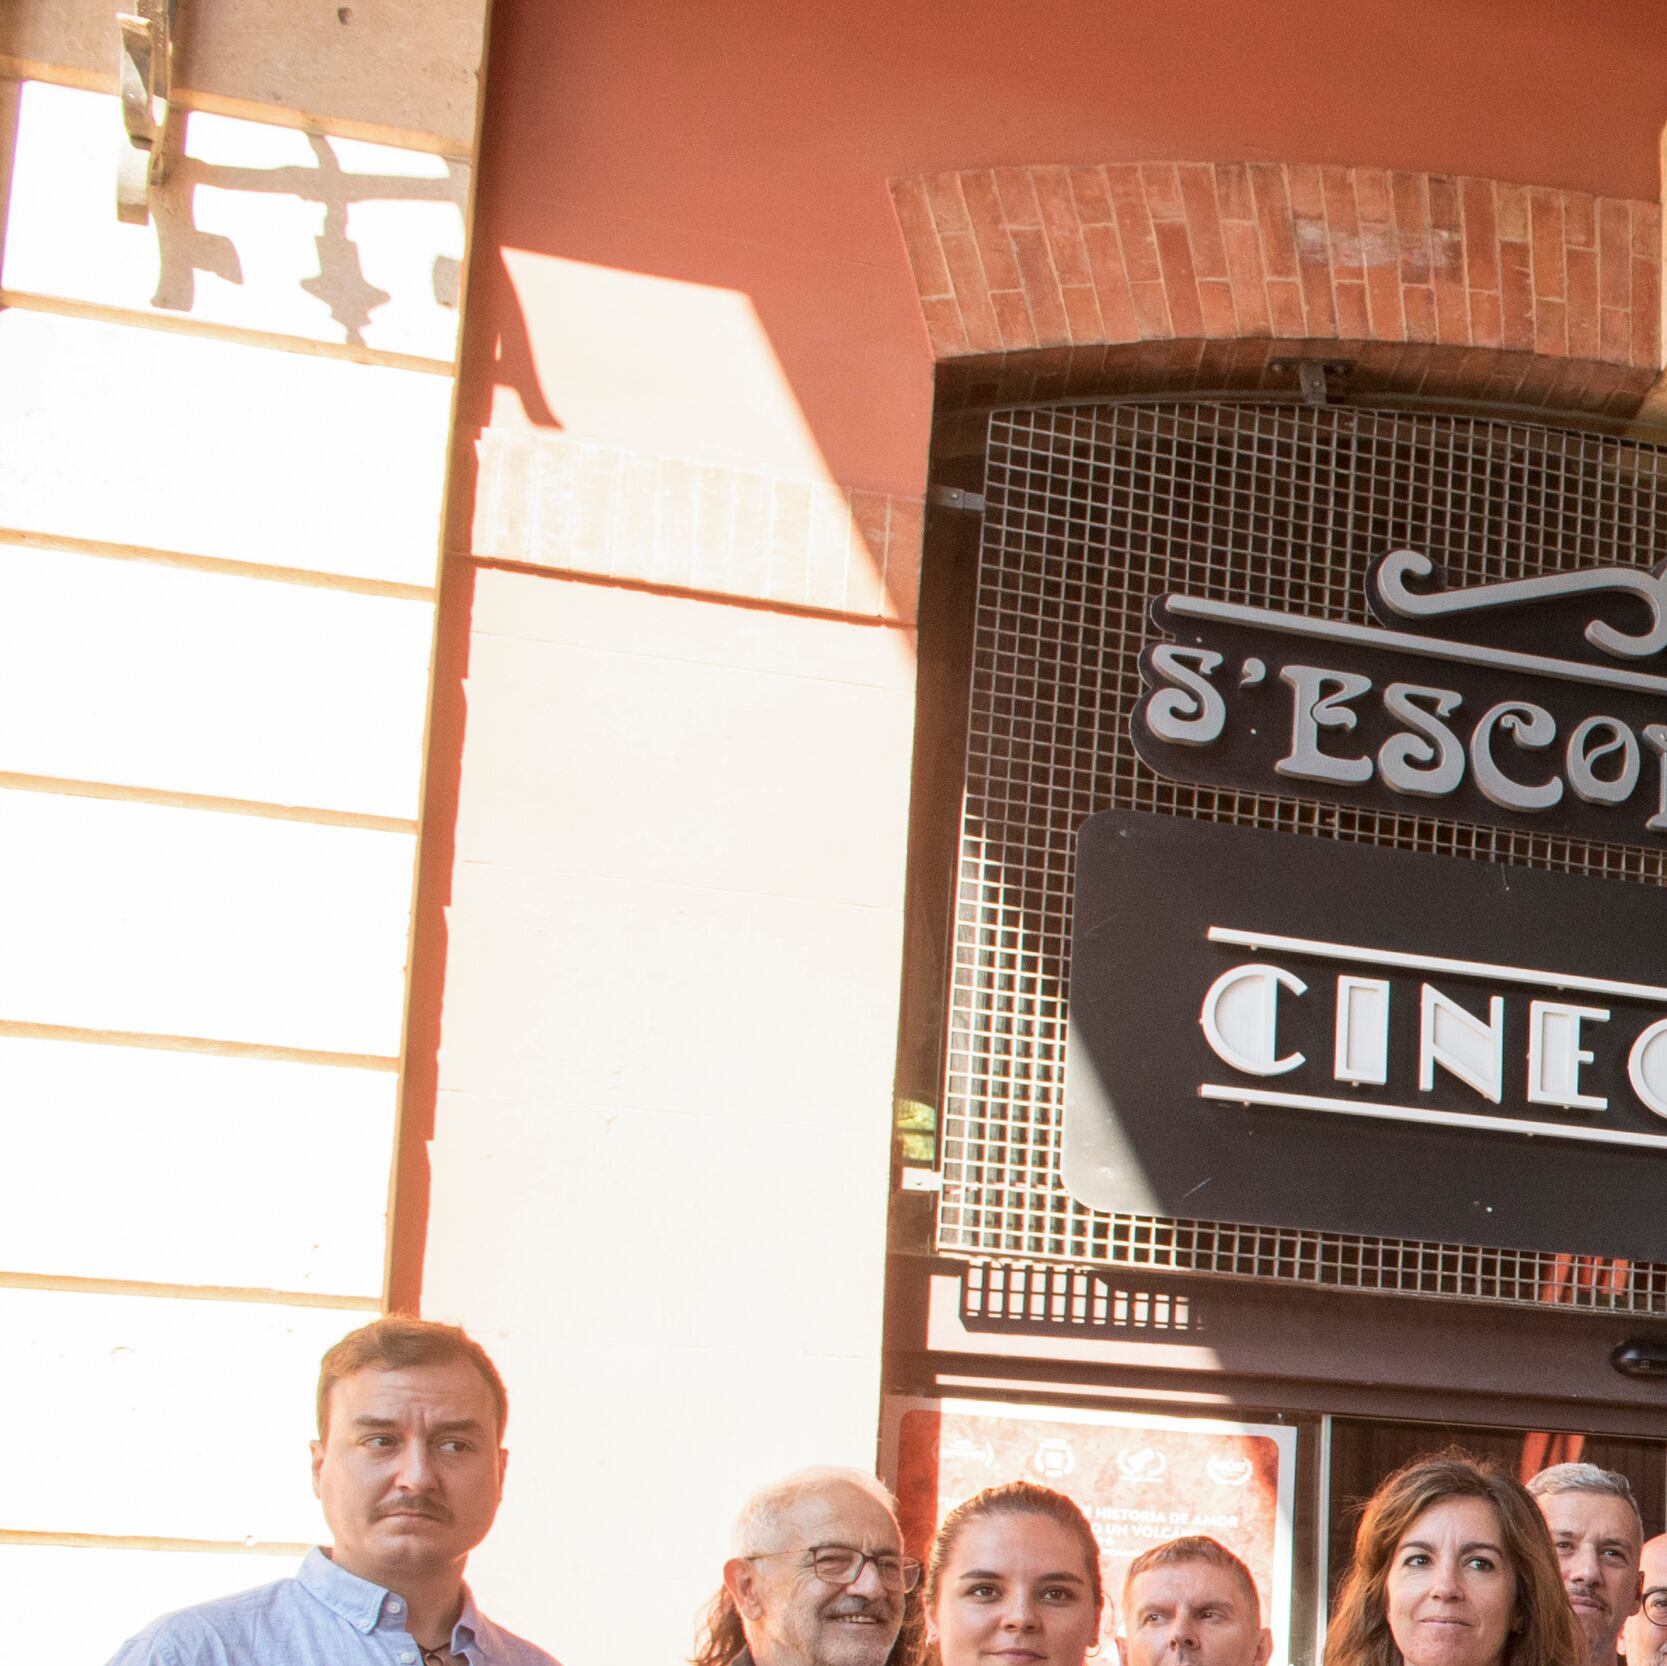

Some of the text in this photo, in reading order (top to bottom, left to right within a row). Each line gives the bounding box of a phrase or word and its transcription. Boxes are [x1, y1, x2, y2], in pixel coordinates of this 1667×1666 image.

[1095, 1506, 1166, 1523] HISTORIA
[1169, 1511, 1189, 1525] DE
[1192, 1513, 1238, 1528] AMOR
[1104, 1523, 1128, 1537] UN
